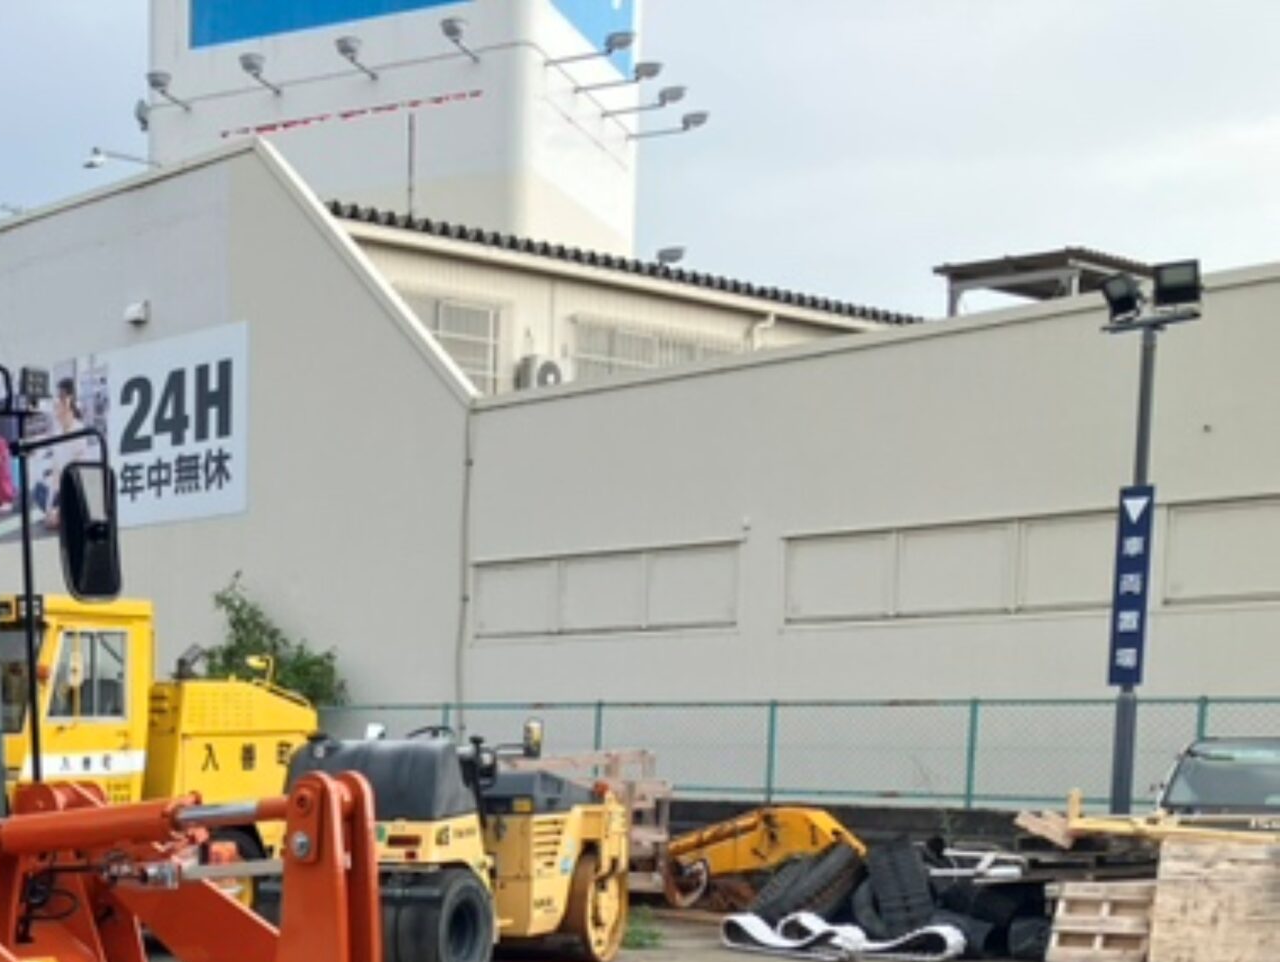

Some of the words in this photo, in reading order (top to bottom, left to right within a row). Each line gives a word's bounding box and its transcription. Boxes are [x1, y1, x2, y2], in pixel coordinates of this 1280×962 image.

[120, 358, 233, 455] 24H
[119, 448, 232, 501] 年中無休
